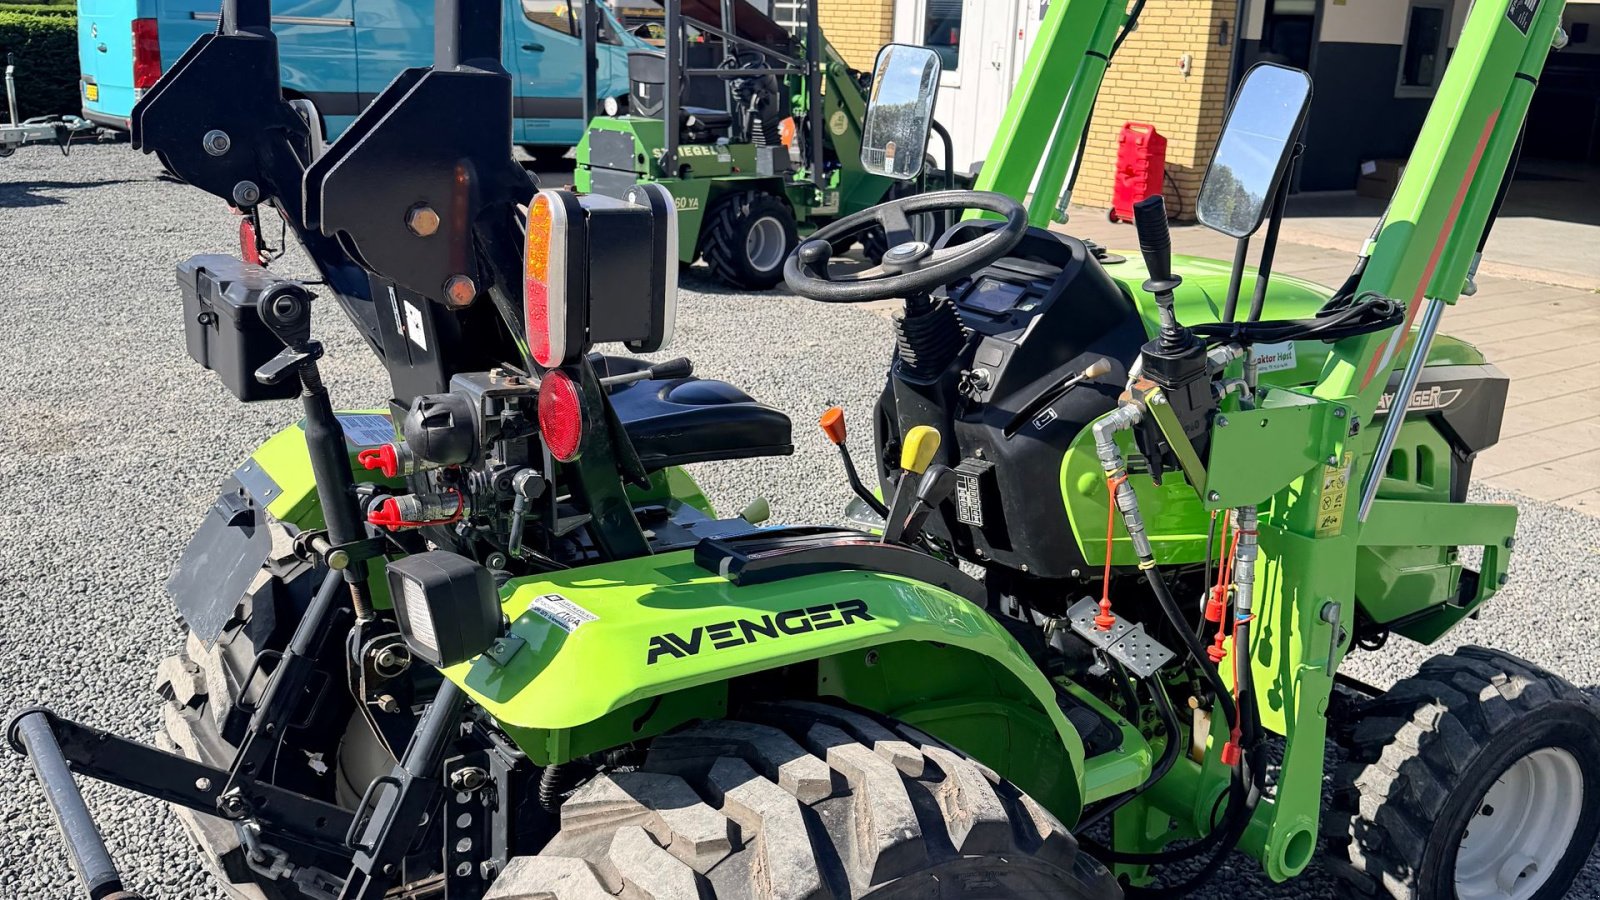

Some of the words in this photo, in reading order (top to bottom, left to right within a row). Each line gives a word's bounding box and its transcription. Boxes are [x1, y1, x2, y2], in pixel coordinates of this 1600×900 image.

[652, 145, 718, 158] STIEGEL
[1256, 354, 1276, 364] aktor
[1377, 386, 1440, 408] AVGER
[647, 599, 876, 665] AVENGER
